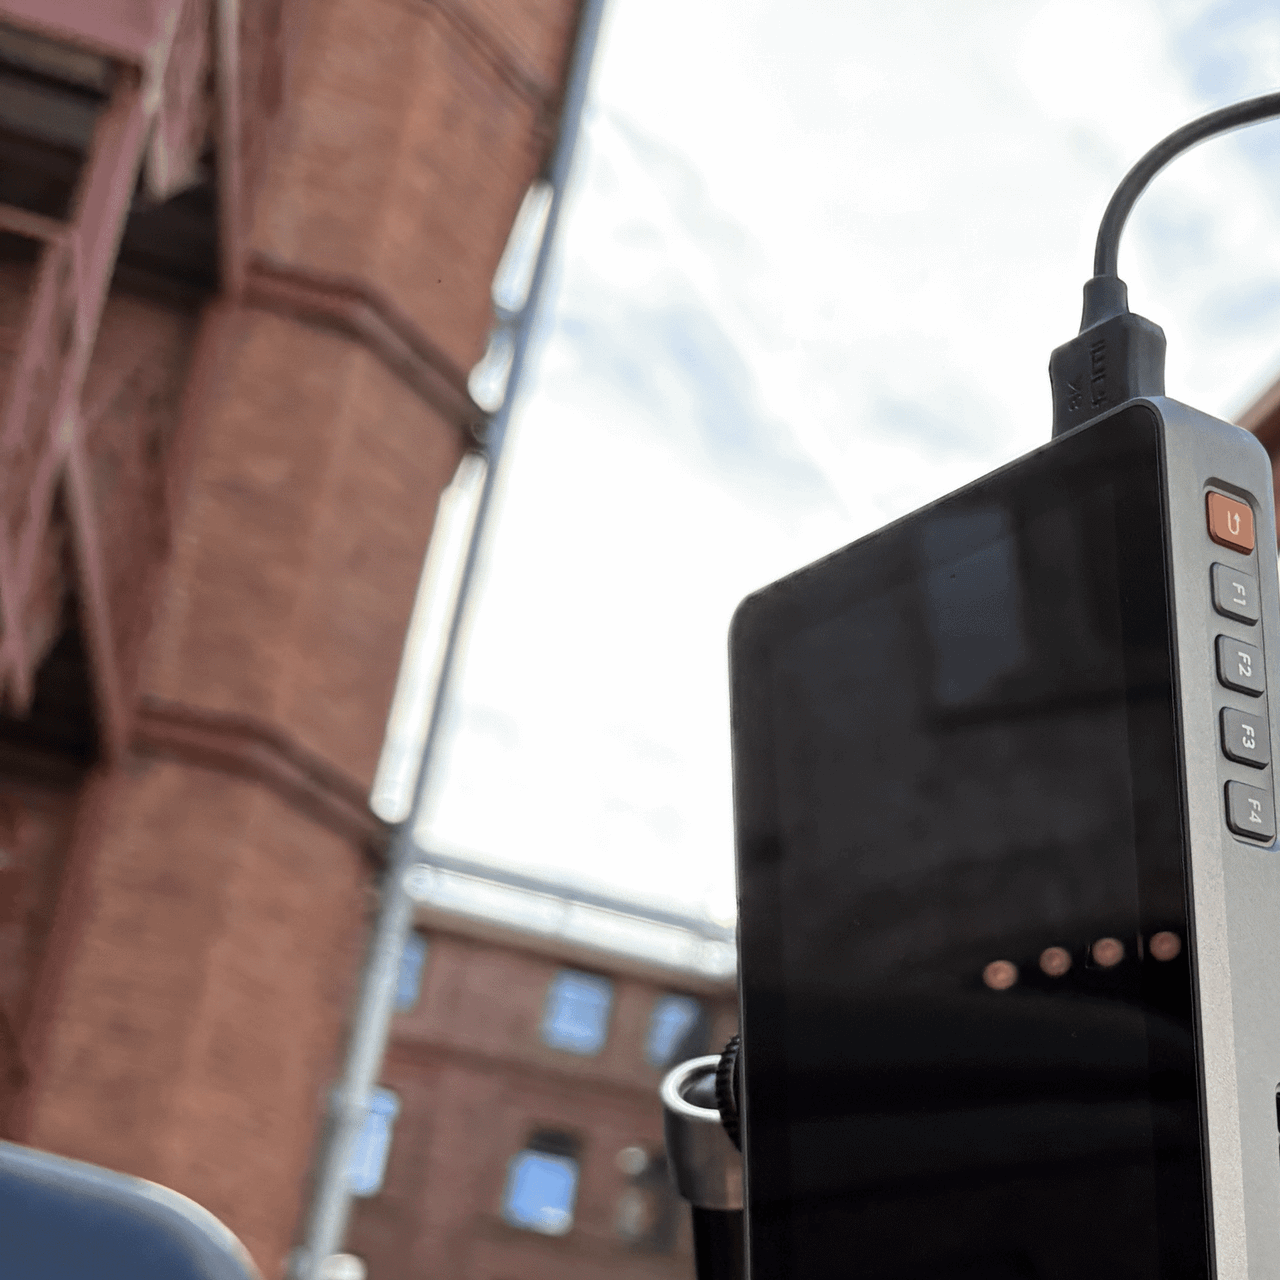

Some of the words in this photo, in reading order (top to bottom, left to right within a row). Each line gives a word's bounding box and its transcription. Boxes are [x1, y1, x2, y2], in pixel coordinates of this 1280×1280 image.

[1232, 581, 1246, 606] F1
[1238, 651, 1252, 677] F2
[1242, 723, 1256, 749] F3
[1248, 798, 1262, 824] F4
